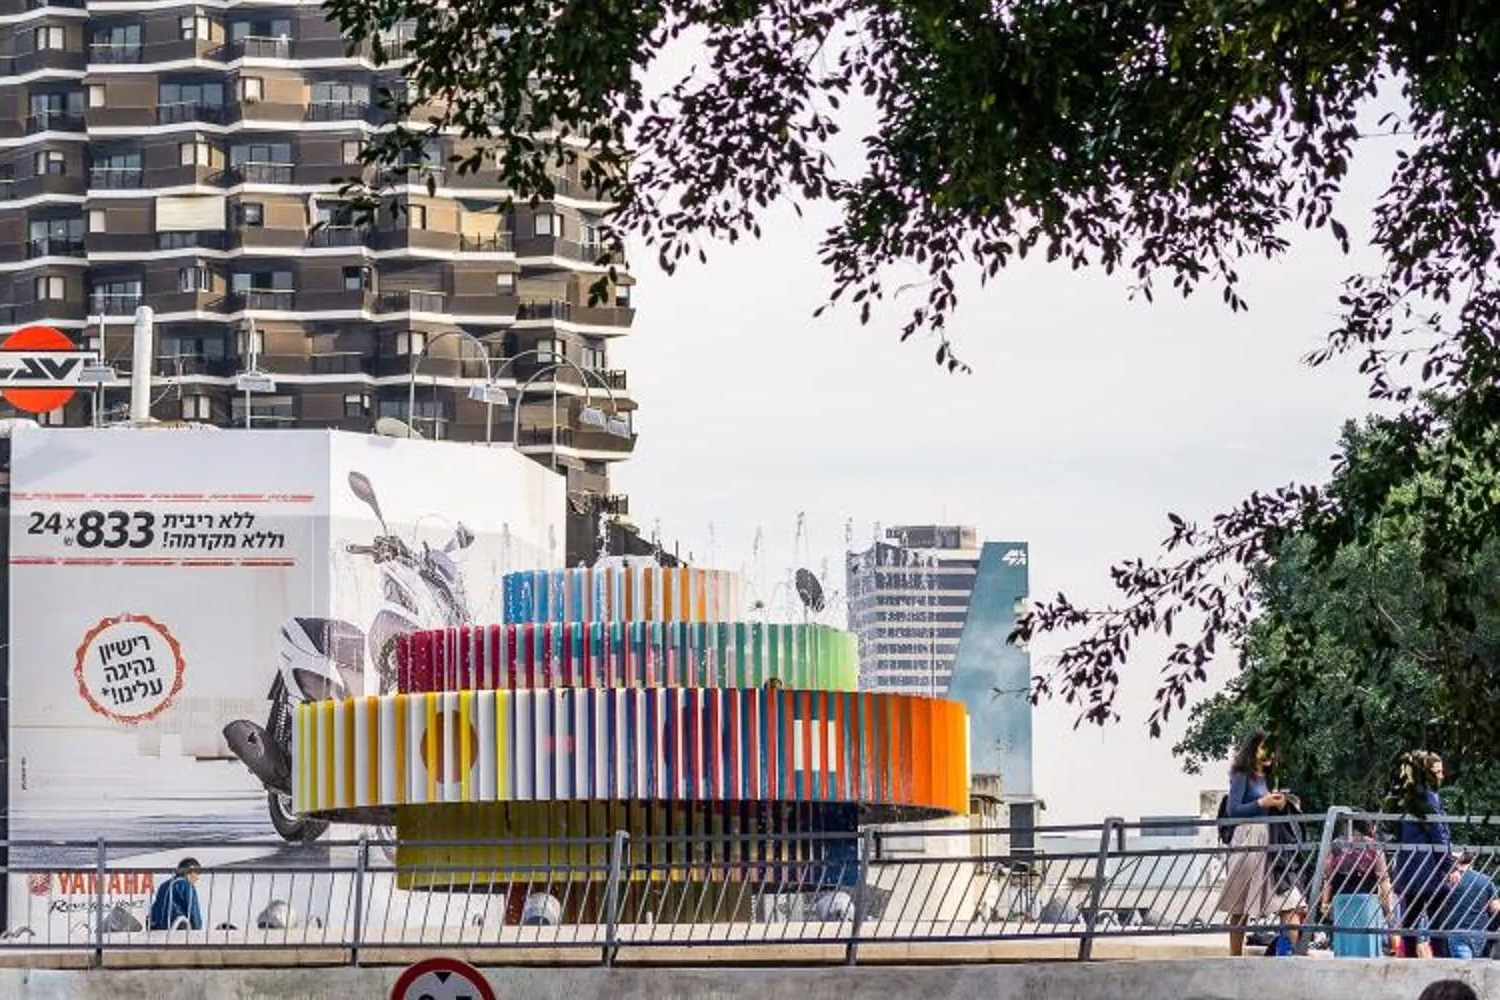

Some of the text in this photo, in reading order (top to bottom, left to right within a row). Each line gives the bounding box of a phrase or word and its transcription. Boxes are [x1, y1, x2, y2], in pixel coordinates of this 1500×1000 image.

[27, 511, 62, 534] 24
[76, 509, 155, 548] 833
[161, 511, 255, 529] ללא ריבית
[162, 531, 285, 550] וללא מקדמה!
[99, 635, 151, 665] רישיון
[103, 657, 155, 683] נהיגה
